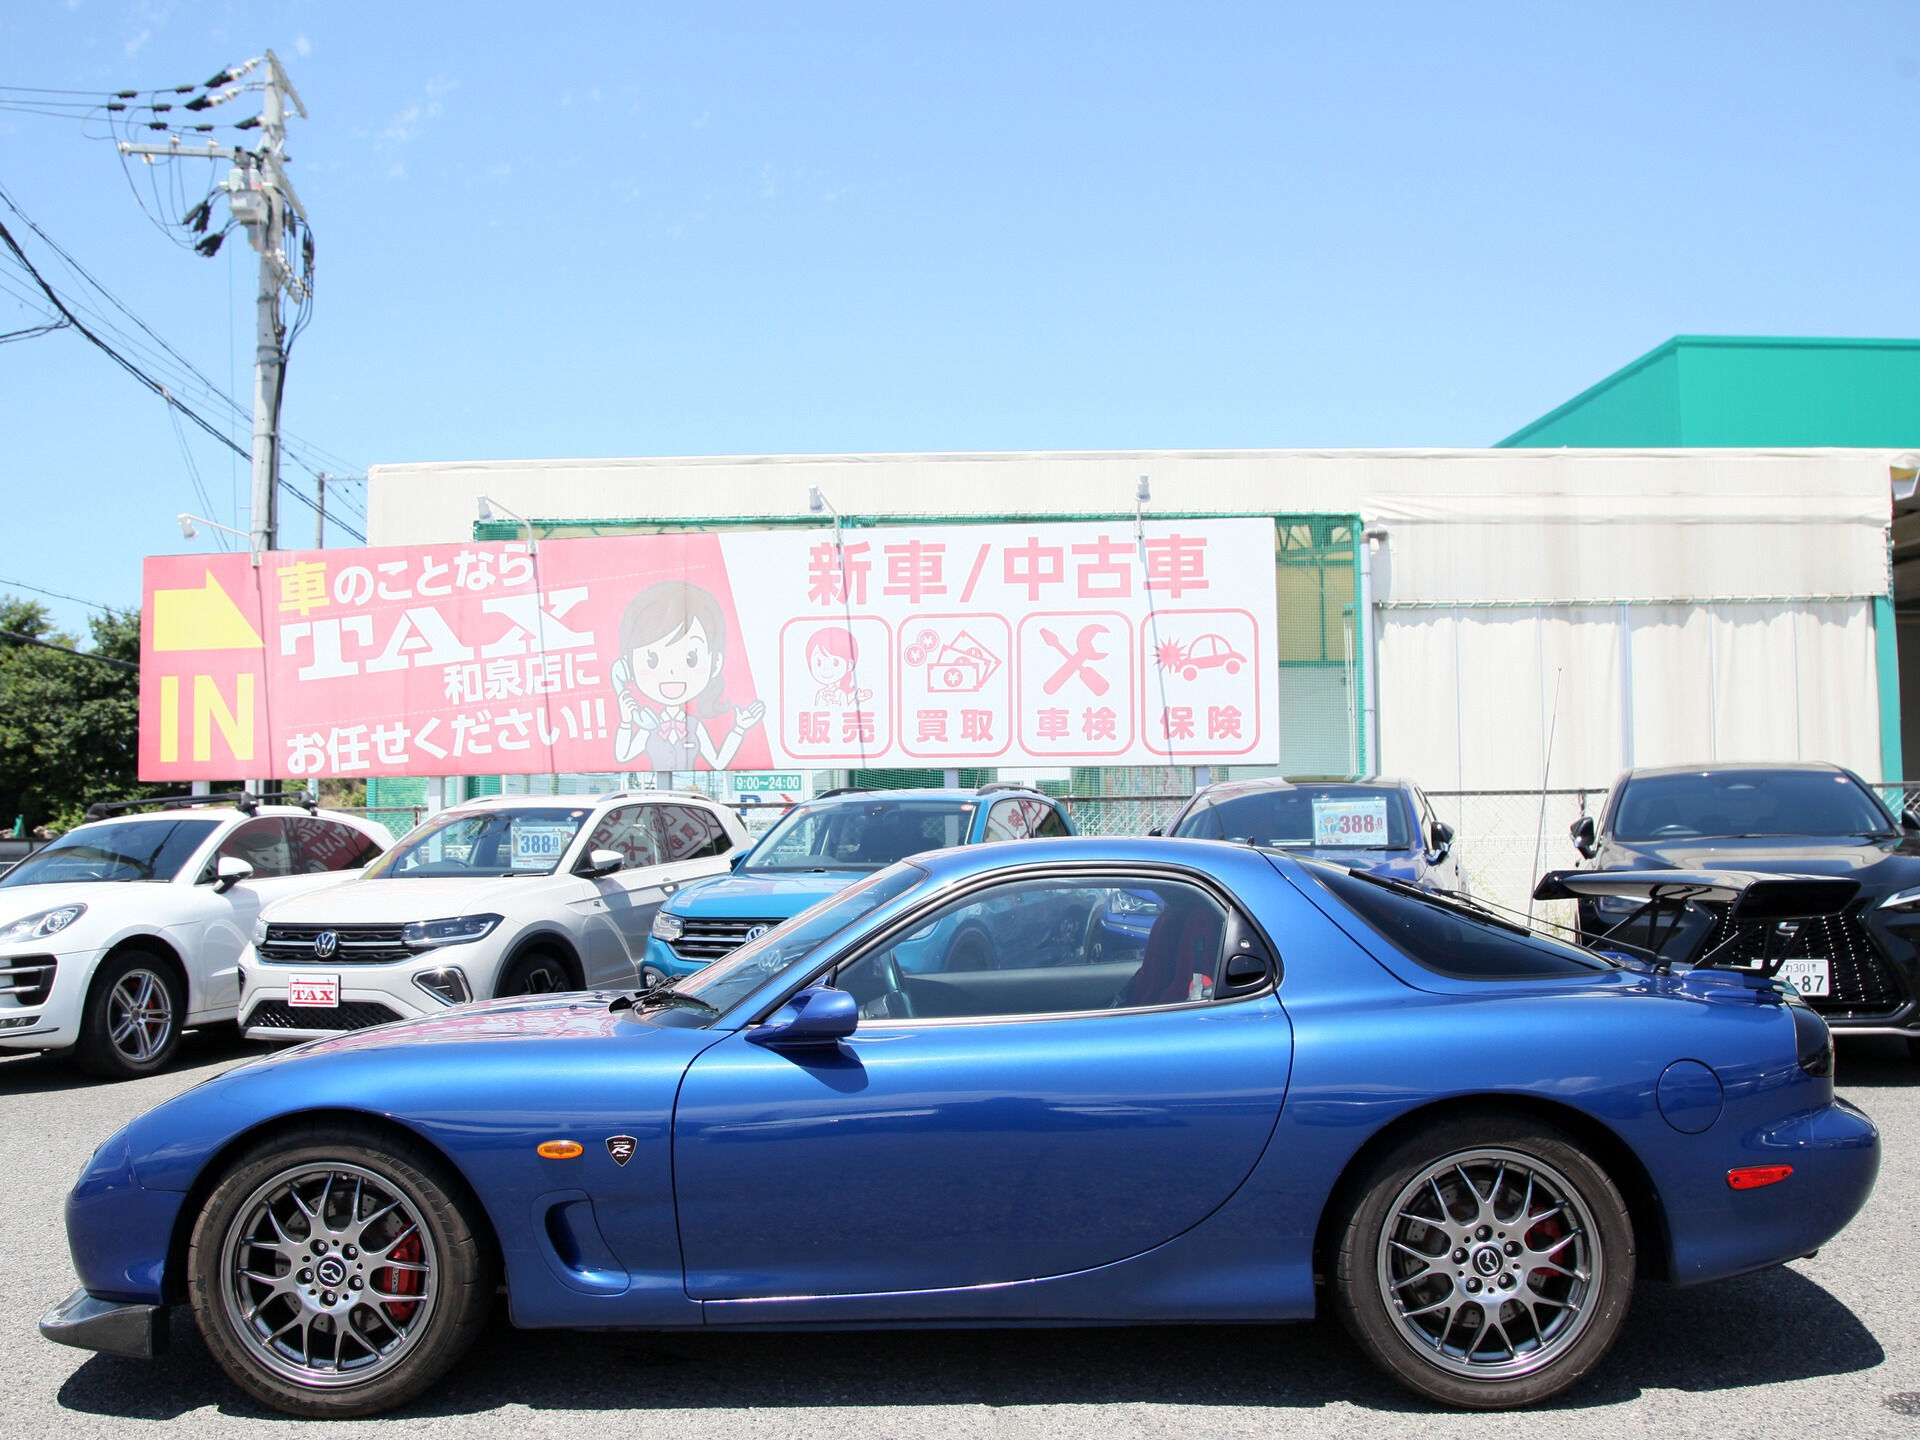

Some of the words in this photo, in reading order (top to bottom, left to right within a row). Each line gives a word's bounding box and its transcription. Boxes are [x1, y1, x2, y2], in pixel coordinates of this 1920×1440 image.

[277, 543, 536, 616] 車のことなら
[807, 533, 1210, 606] 新車/中古車
[280, 586, 595, 682] TAX
[445, 652, 601, 705] 和泉店に
[160, 673, 255, 763] IN
[797, 710, 876, 745] 販売
[916, 709, 994, 743] 買取
[1036, 707, 1117, 742] 車検
[1160, 705, 1243, 741] 保険
[292, 989, 334, 1001] TAX
